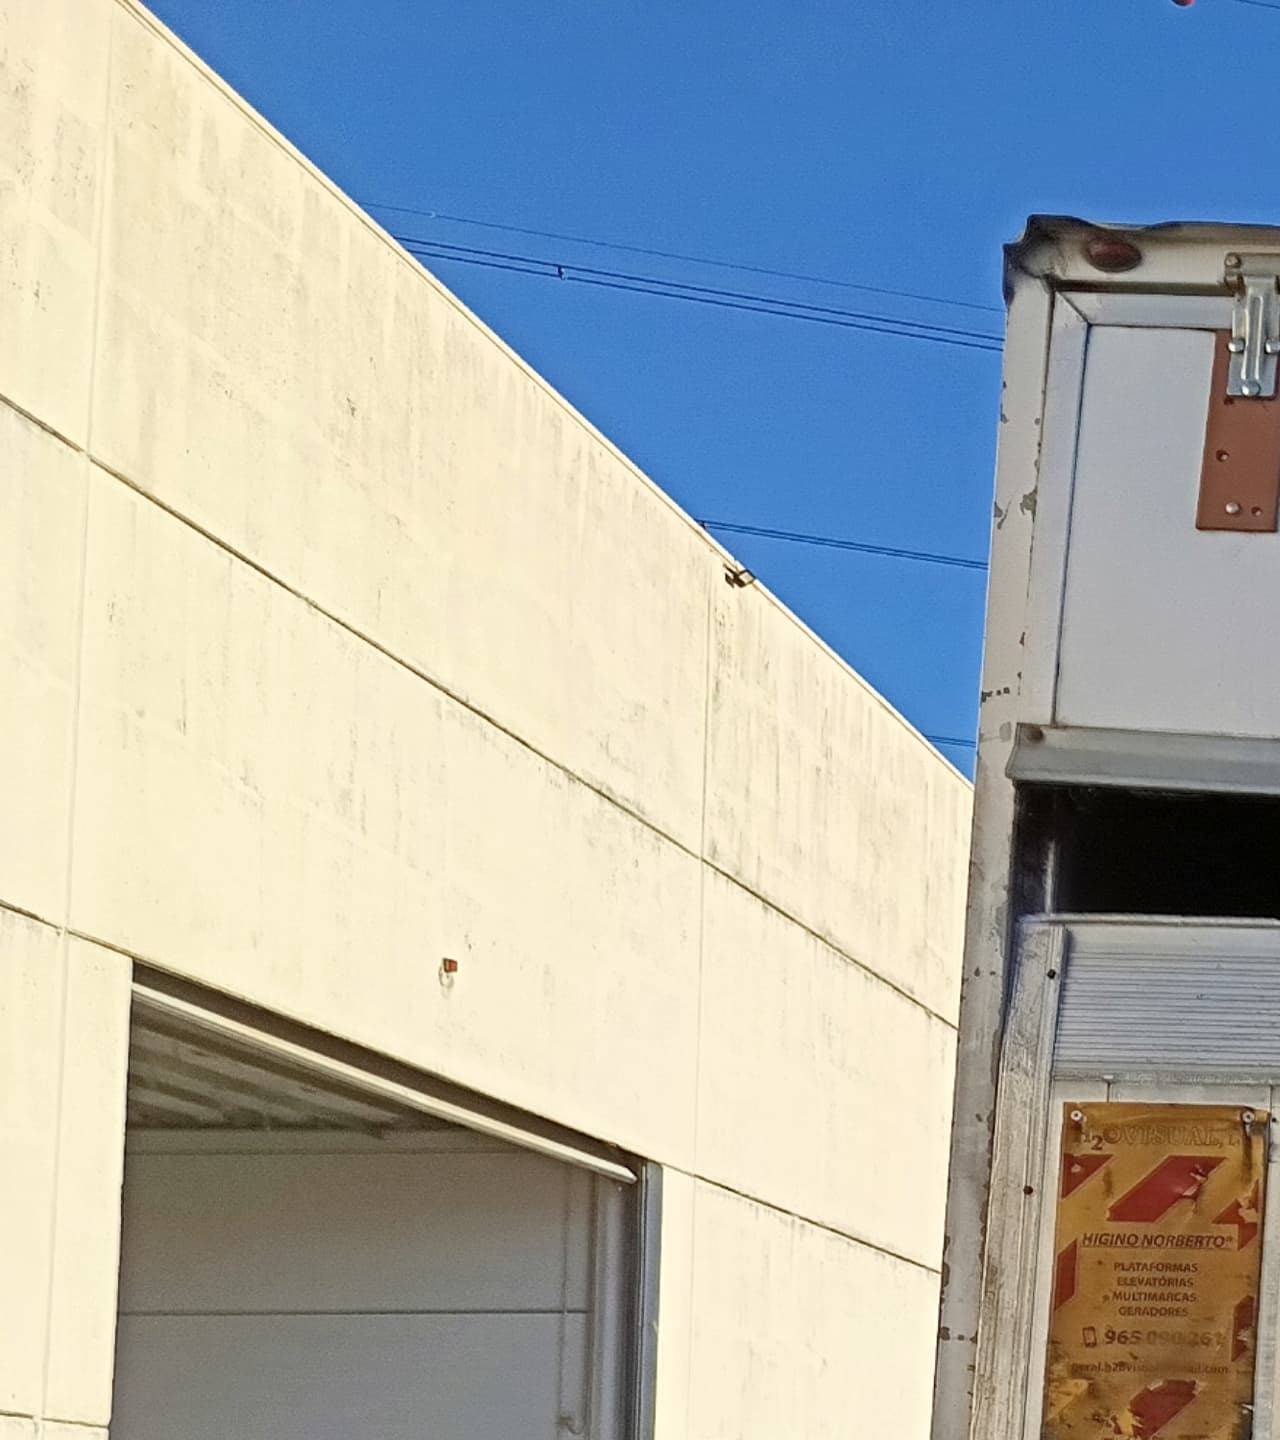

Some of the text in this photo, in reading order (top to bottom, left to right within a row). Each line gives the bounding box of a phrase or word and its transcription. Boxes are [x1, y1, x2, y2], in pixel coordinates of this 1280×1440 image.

[1082, 1232, 1139, 1247] HIGINO
[1113, 1262, 1199, 1273] PLATAFORMAS
[1112, 1290, 1197, 1302] MULTIMARCAS
[1118, 1306, 1189, 1317] GERADORES
[1104, 1329, 1142, 1345] 965
